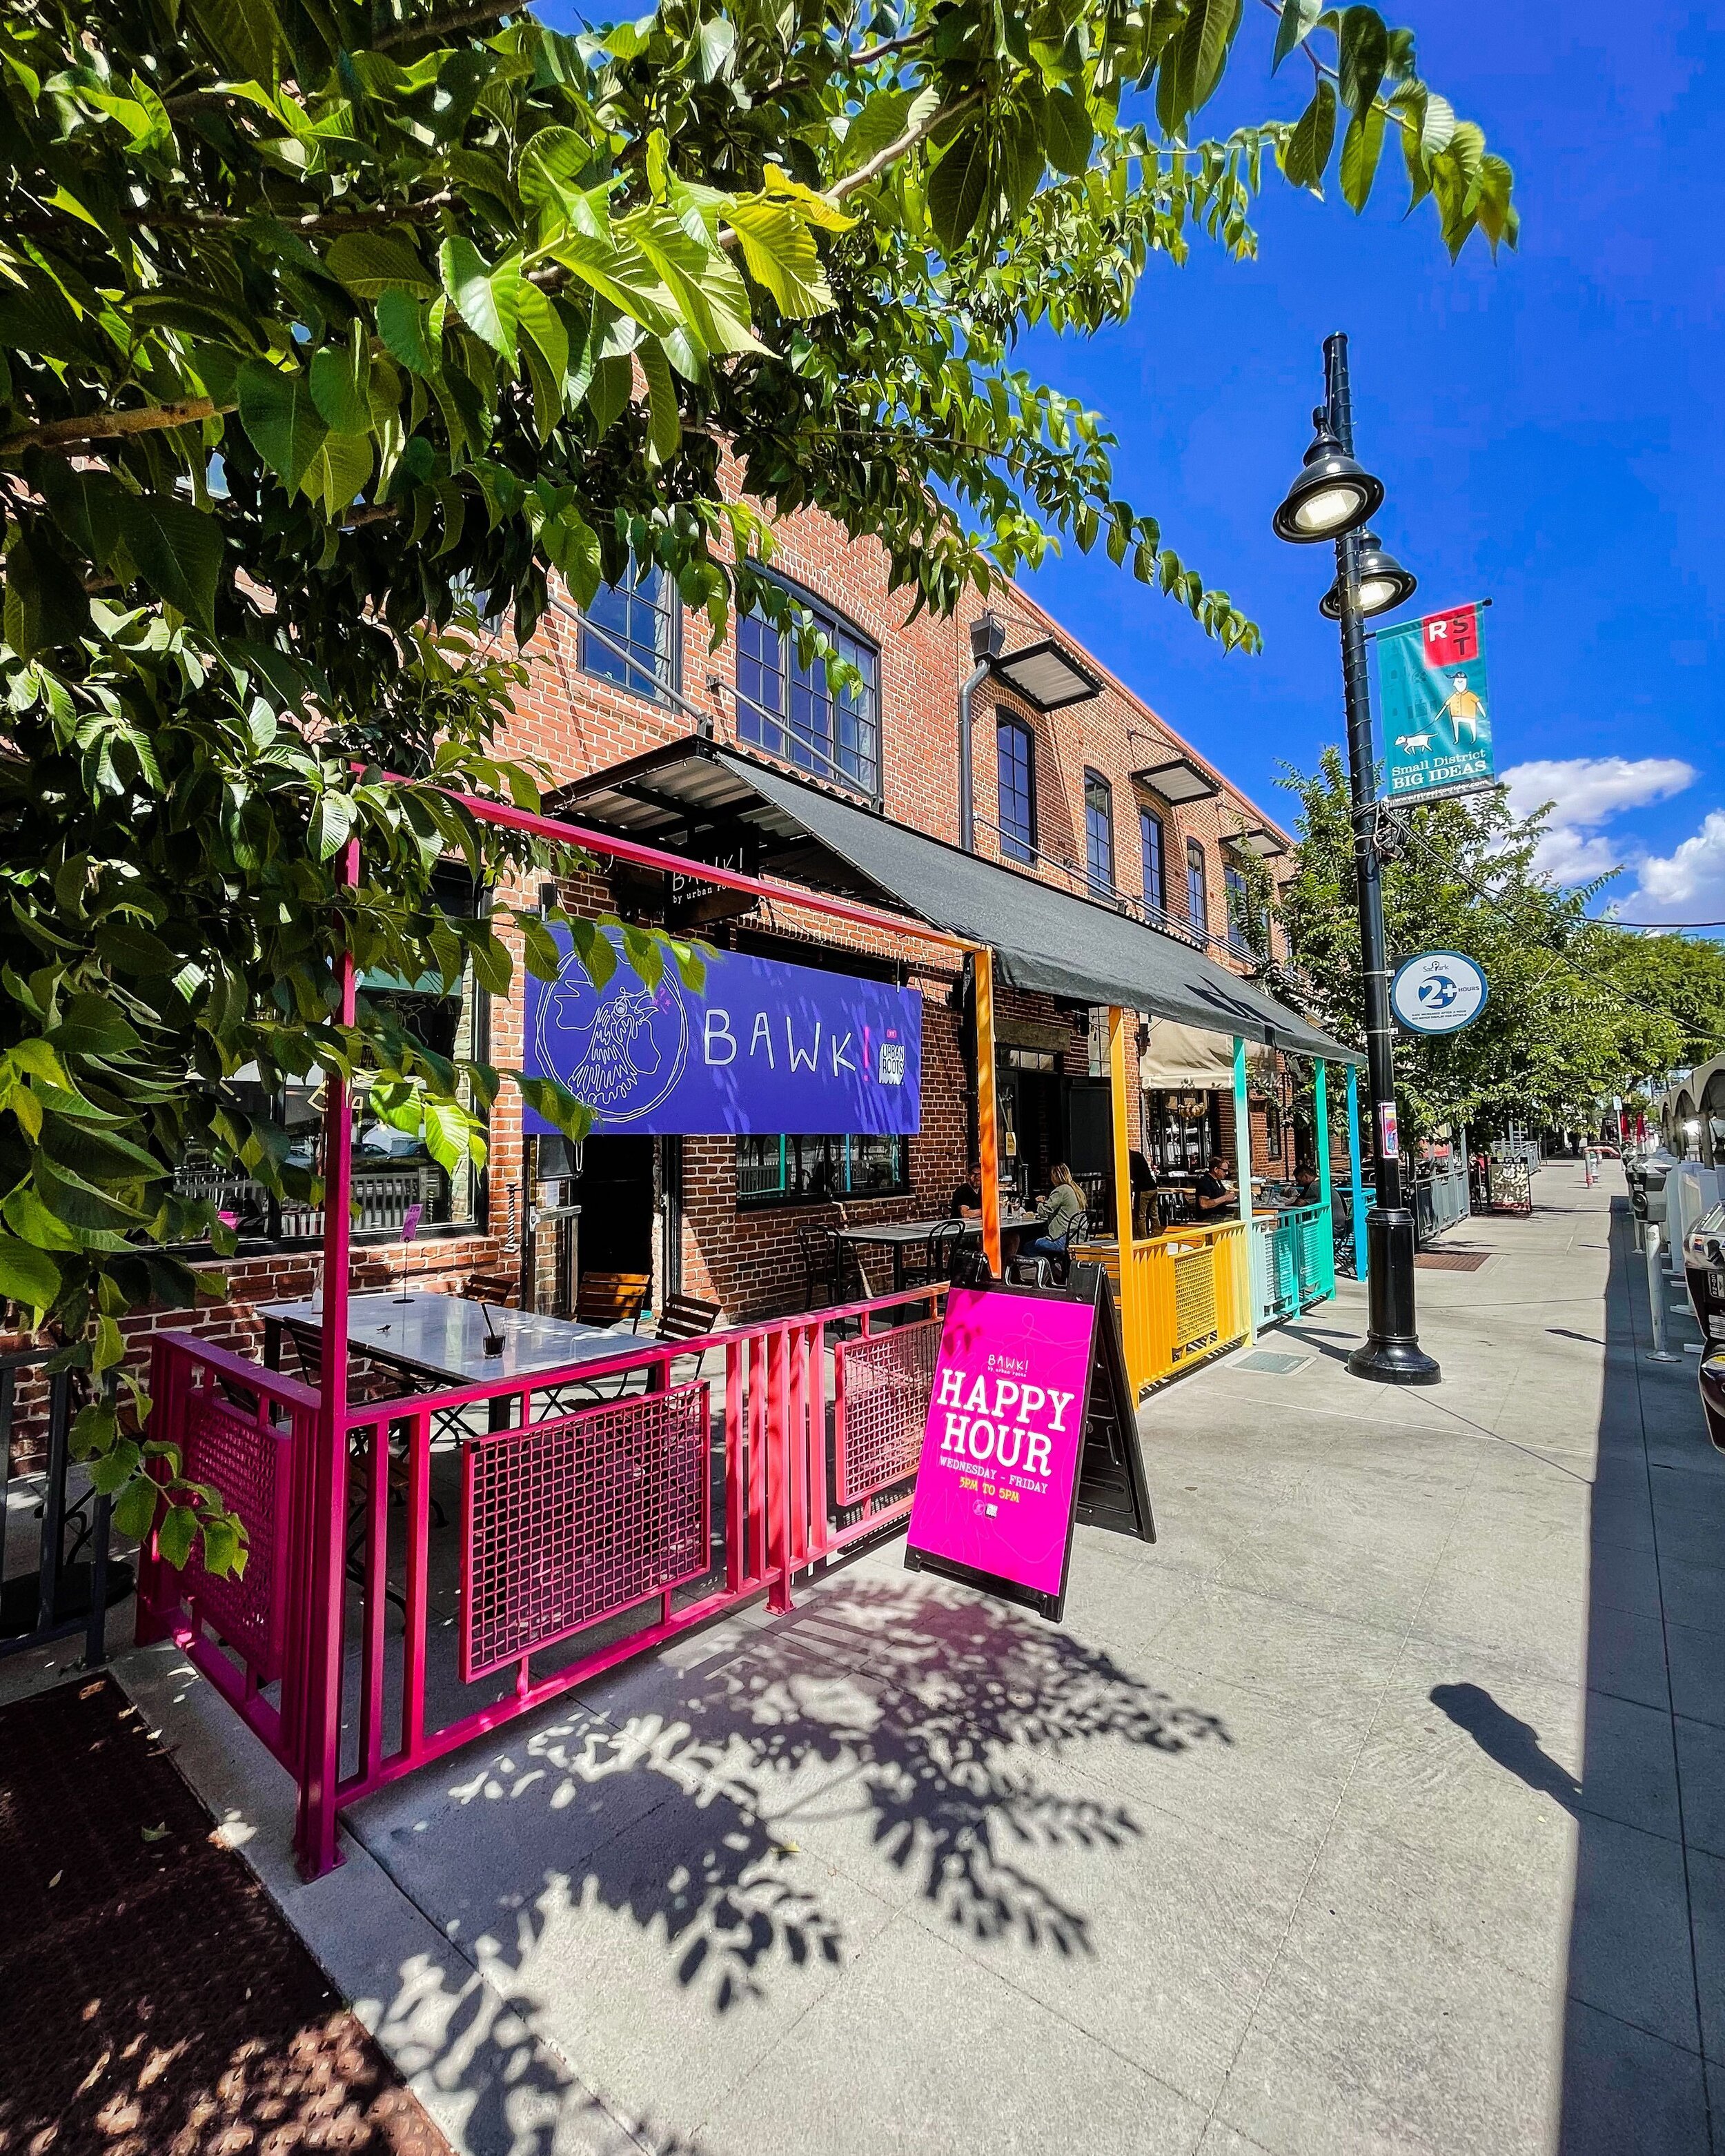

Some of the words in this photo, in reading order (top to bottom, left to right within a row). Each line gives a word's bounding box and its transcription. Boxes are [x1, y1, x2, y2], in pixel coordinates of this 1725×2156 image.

[1392, 760, 1430, 776] Small
[1433, 749, 1486, 768] District
[1392, 773, 1425, 789] BIG
[1429, 760, 1487, 782] IDEAS
[673, 896, 682, 904] by
[687, 887, 712, 900] urban
[1419, 979, 1457, 1006] 2+
[704, 1009, 870, 1082] BAWK!
[883, 1042, 905, 1060] URBAN
[883, 1058, 904, 1075] ROOTS
[987, 1354, 1028, 1373] BAWK!
[936, 1368, 1075, 1432] HAPPY
[940, 1412, 1052, 1477] HOUR
[940, 1456, 997, 1480] WEDNESDAY
[1009, 1474, 1049, 1494] FRIDAY
[958, 1476, 978, 1492] 3PM
[983, 1483, 996, 1496] TO
[998, 1487, 1020, 1503] 5PM
